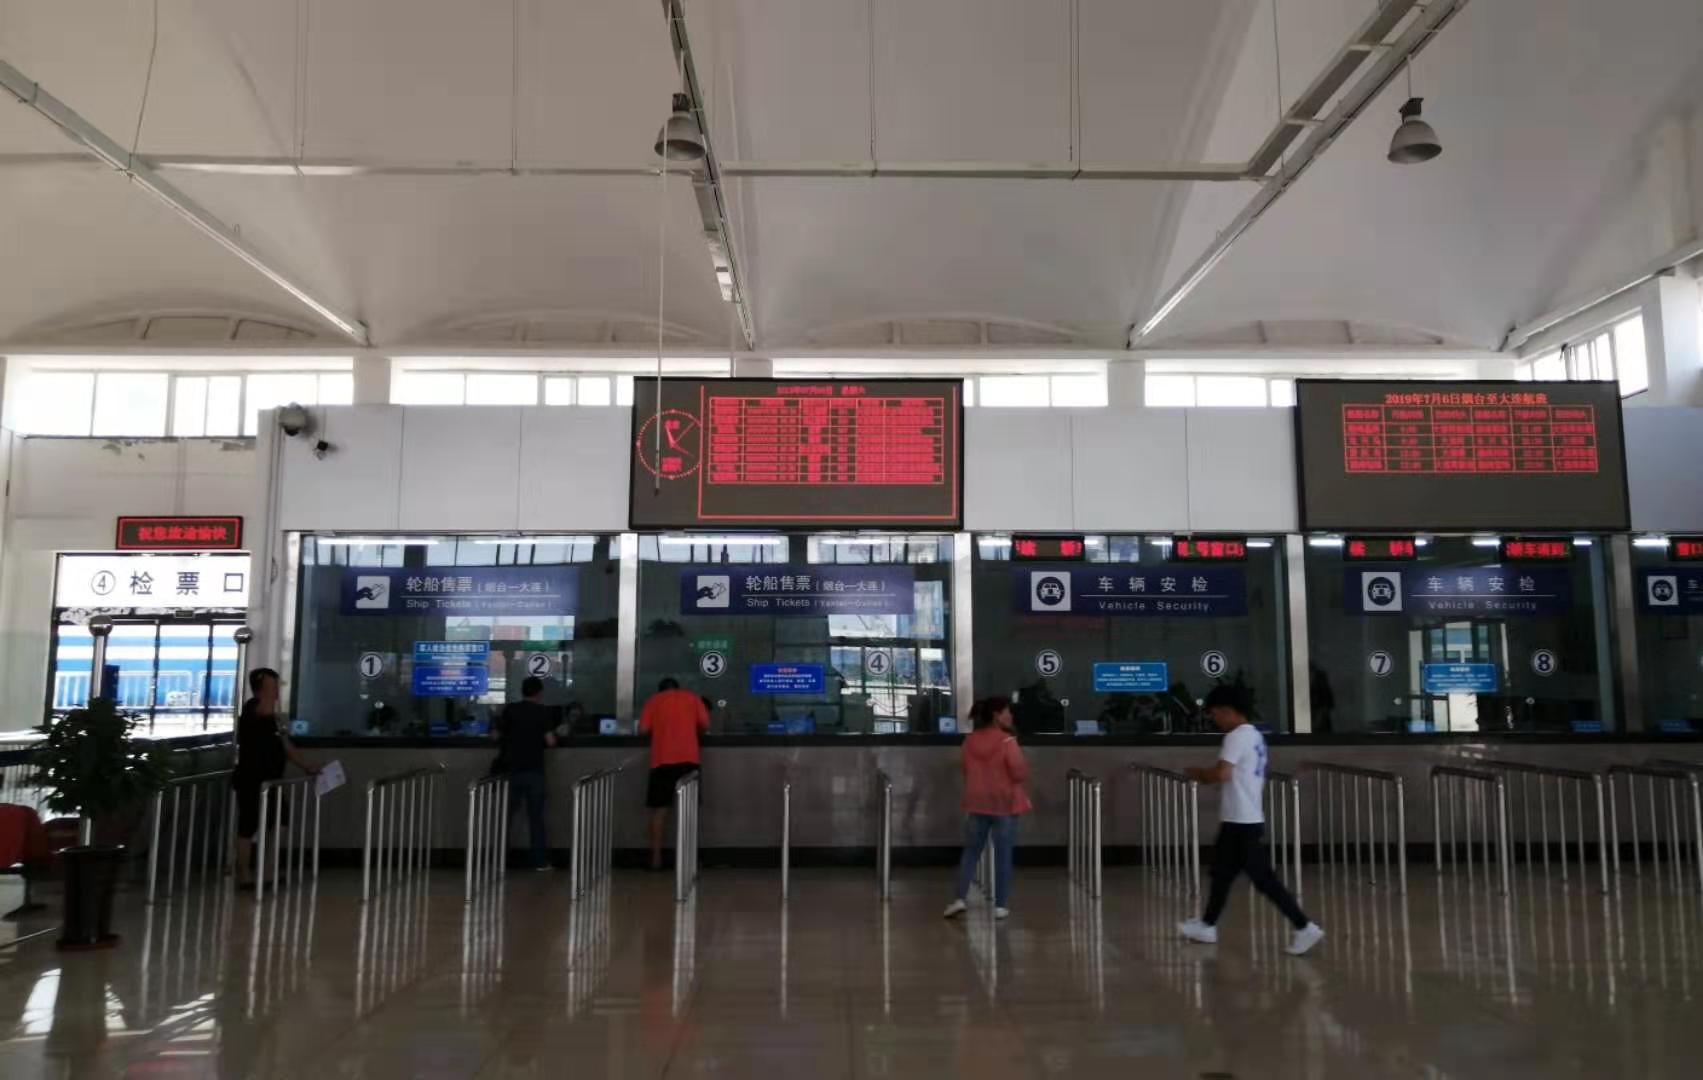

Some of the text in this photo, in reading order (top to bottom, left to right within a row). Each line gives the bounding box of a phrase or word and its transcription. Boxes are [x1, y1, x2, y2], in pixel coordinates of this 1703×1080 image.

[130, 570, 244, 596] 检票口
[406, 576, 473, 593] 轮船售票
[746, 575, 811, 592] 轮船售票
[1098, 576, 1208, 592] 车辆安检
[1427, 576, 1536, 592] 车辆安检
[406, 600, 430, 609] Ship
[436, 600, 471, 609] Tickets
[747, 599, 769, 608] Ship
[776, 599, 810, 608] Tickets
[1099, 600, 1210, 612] Vehicle Security
[1428, 600, 1537, 610] Vehicle Security
